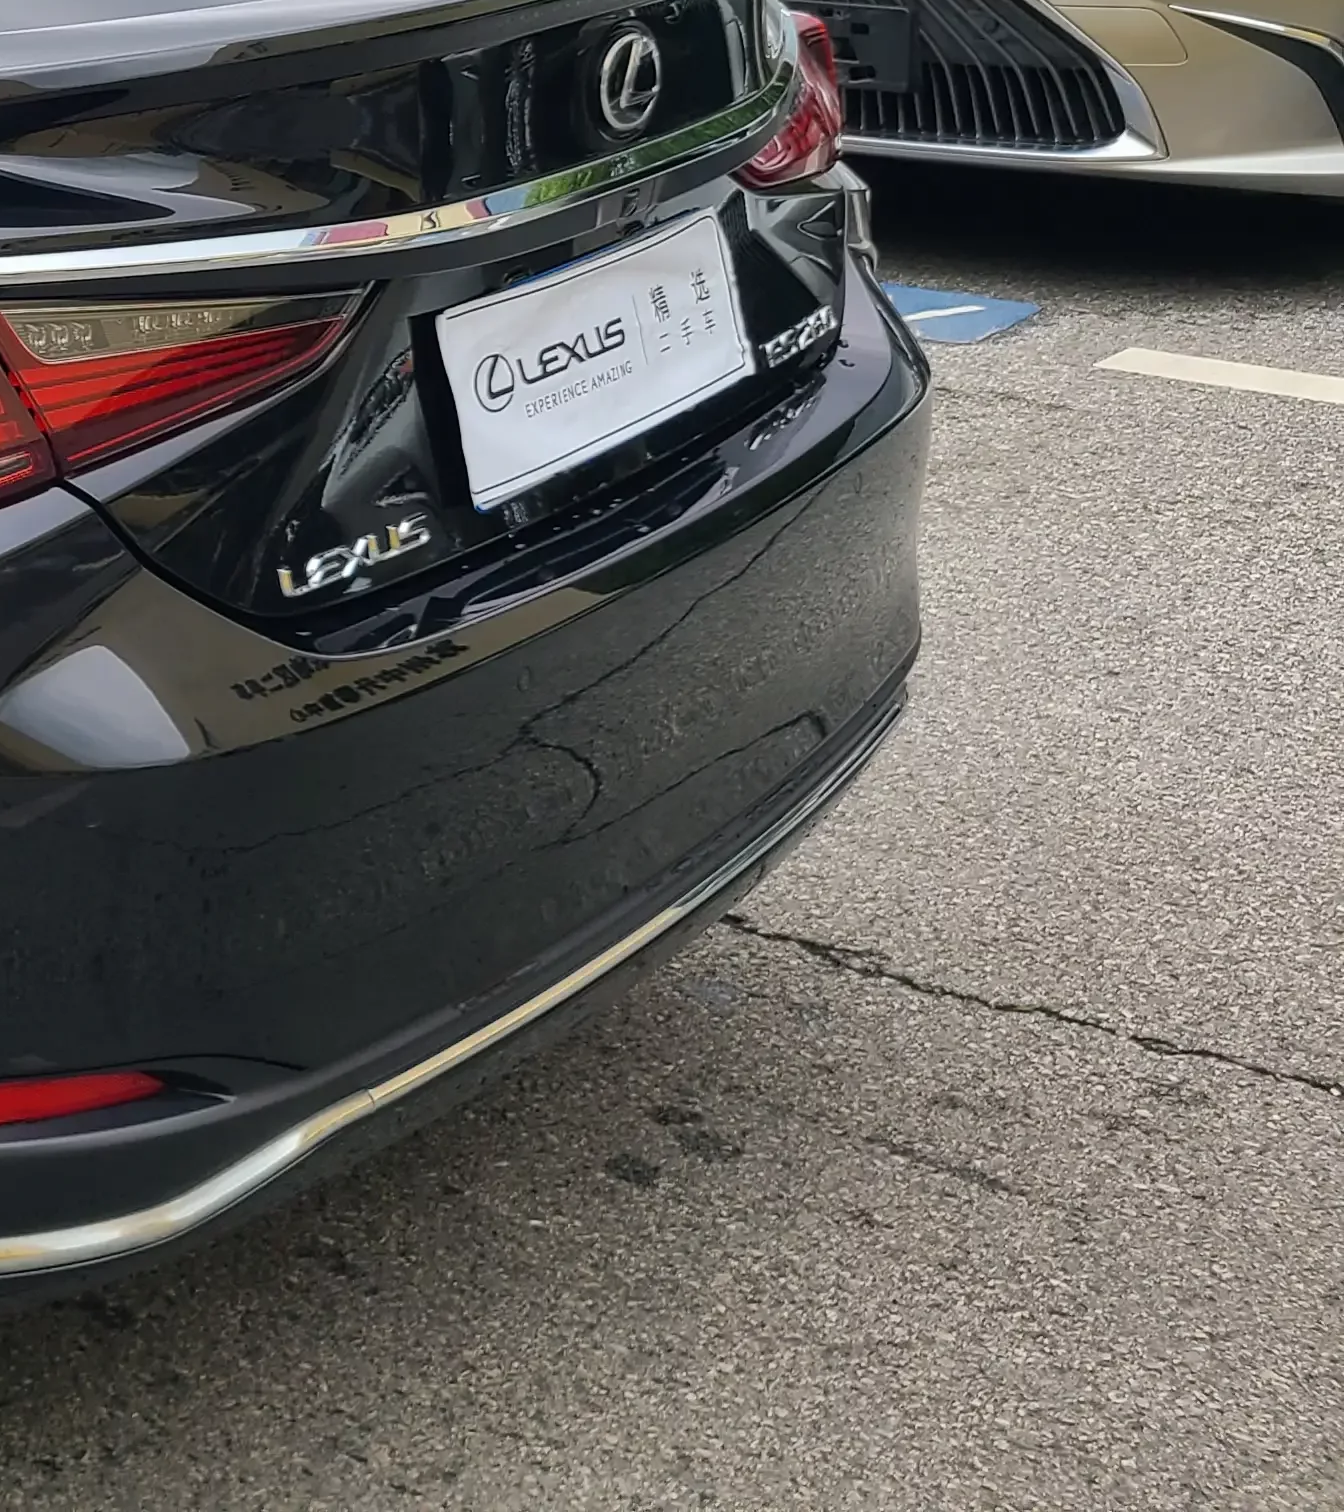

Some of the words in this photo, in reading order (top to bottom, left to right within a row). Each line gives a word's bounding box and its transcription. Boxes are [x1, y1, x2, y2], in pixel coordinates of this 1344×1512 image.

[516, 317, 626, 385] LEXUS
[525, 380, 589, 419] EXPERIENCE
[591, 360, 633, 390] AMAZING
[276, 512, 431, 598] LEXUS
